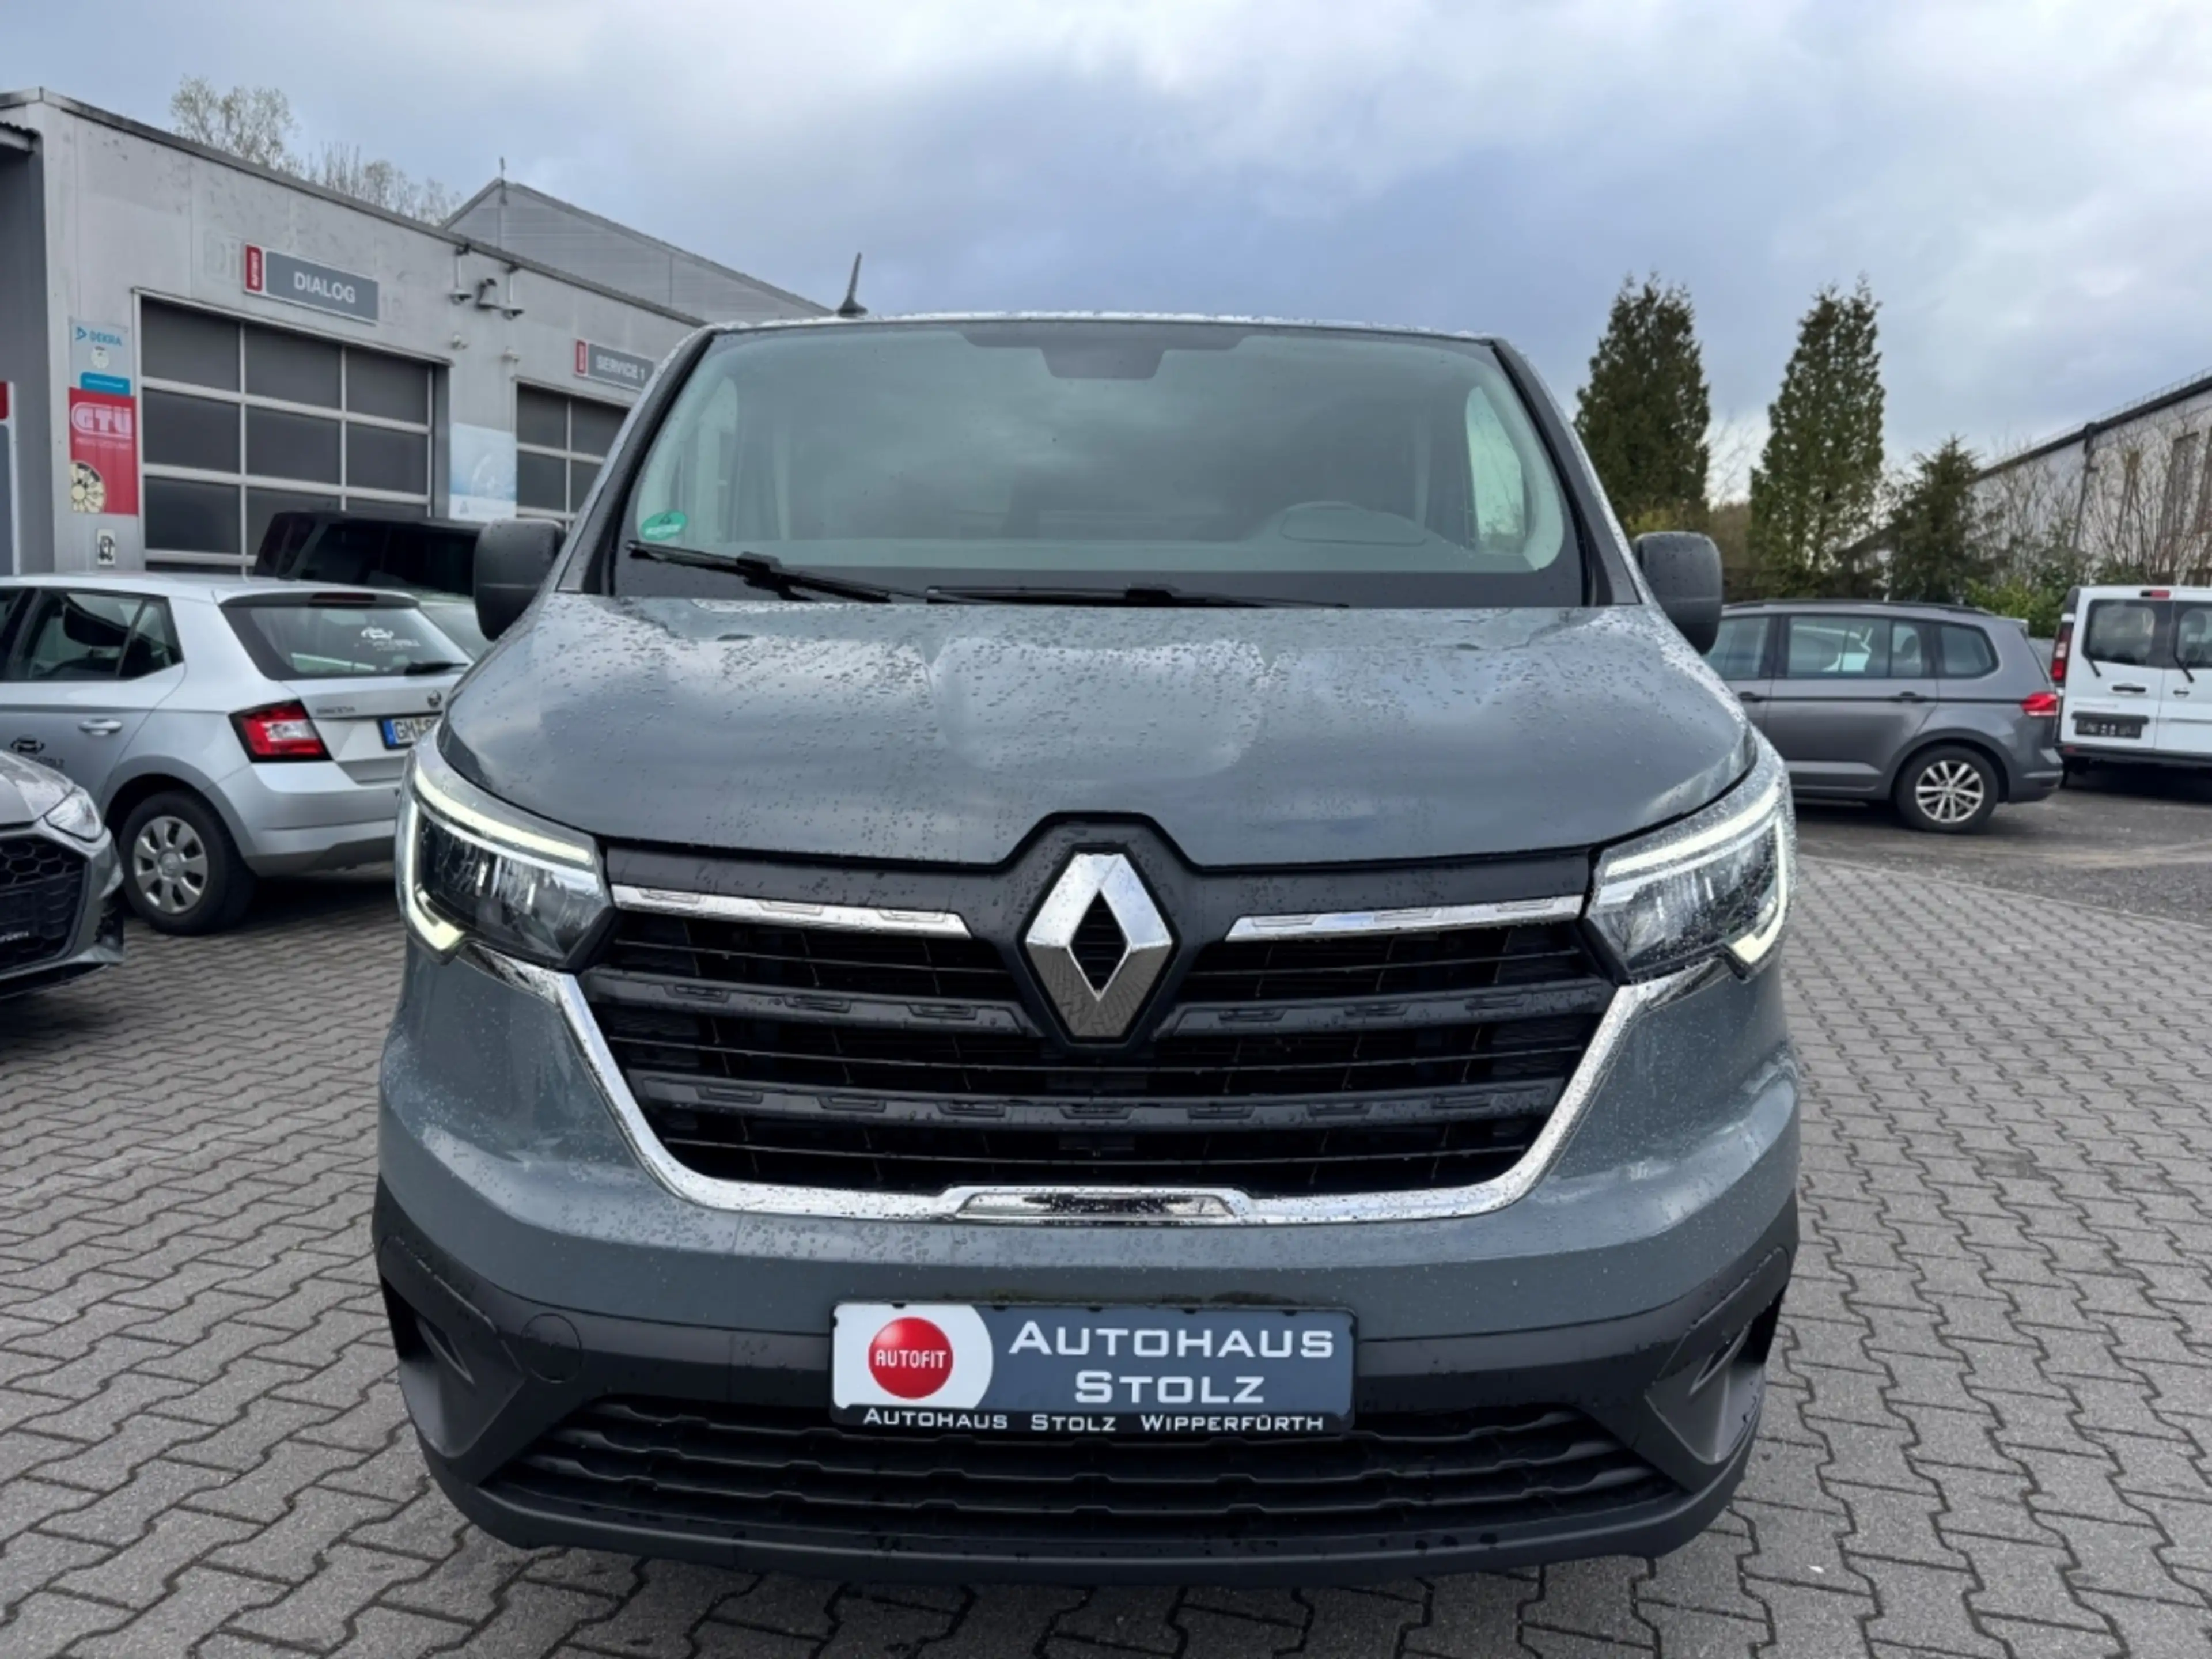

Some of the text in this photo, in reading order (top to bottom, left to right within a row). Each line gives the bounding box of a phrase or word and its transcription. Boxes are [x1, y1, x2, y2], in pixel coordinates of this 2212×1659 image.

[294, 271, 355, 304] DIALOG
[1009, 1321, 1333, 1358] AUTOHAUS
[875, 1349, 946, 1368] AUTOFIT
[1075, 1370, 1264, 1404] STOLZ
[863, 1407, 1324, 1431] AUTOHAUS STOLZ WIPPERFÜRTH
